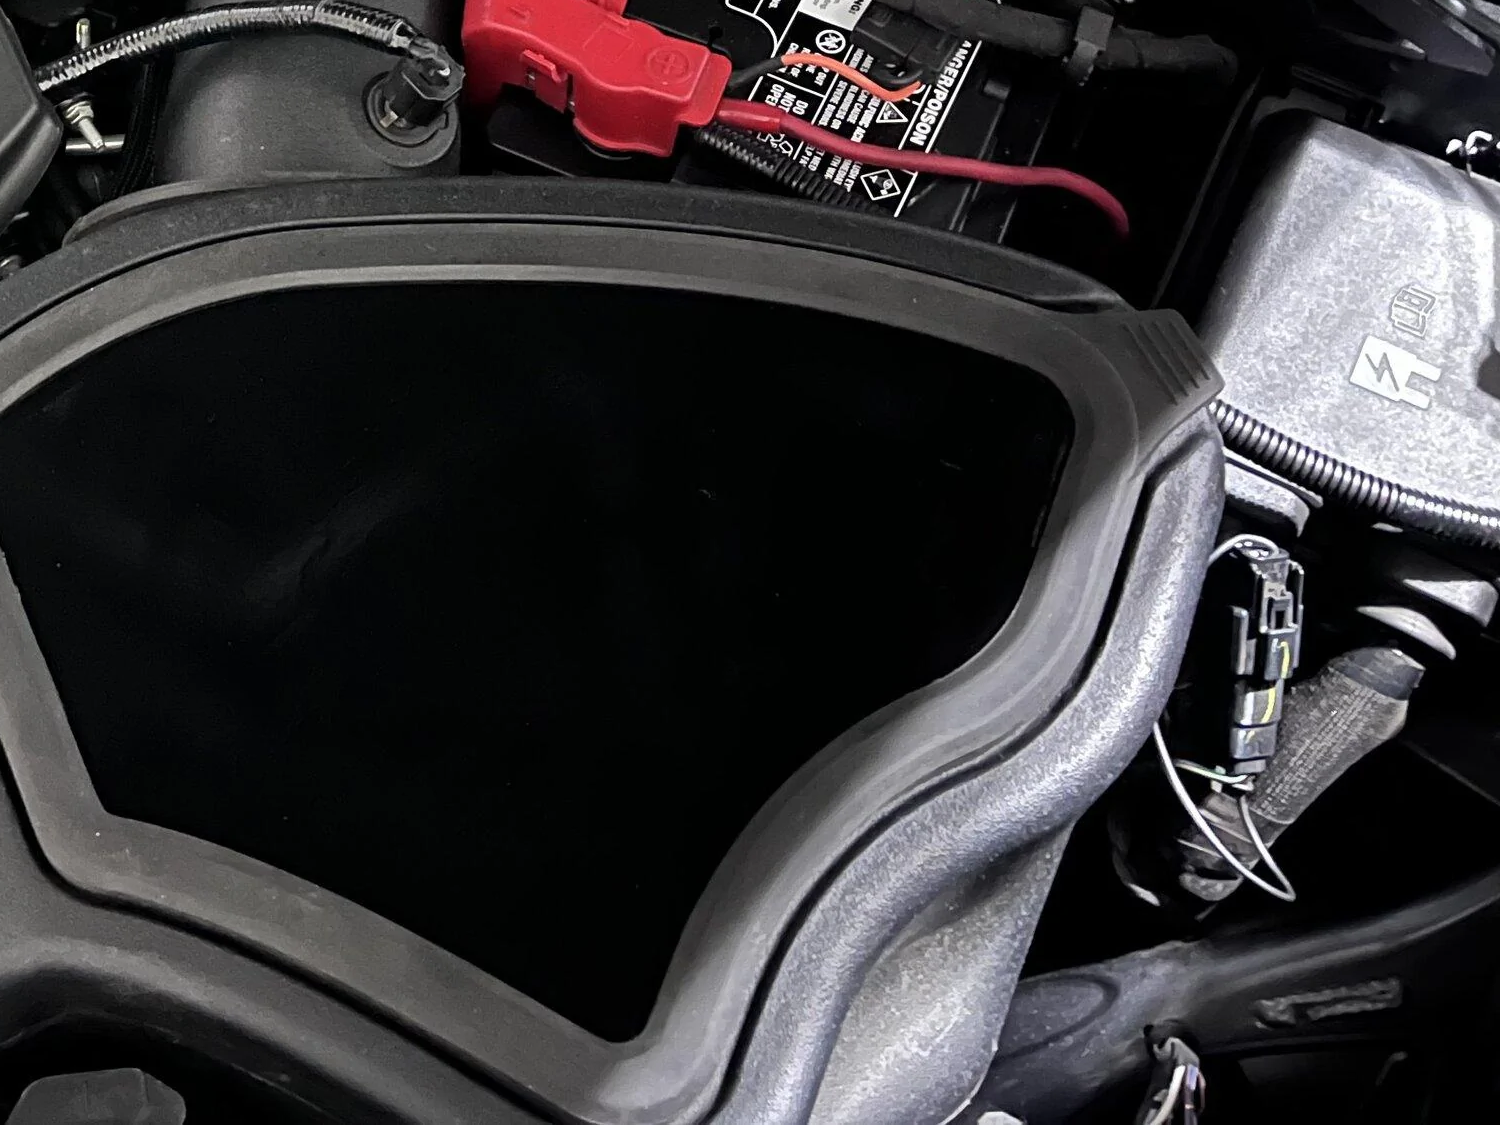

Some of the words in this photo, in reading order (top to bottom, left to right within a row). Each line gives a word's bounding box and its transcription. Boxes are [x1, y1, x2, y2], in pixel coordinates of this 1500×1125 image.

[860, 54, 874, 73] AMES
[765, 84, 784, 107] OPE
[778, 92, 796, 113] NOT
[910, 41, 971, 145] ANGER/POISON
[792, 100, 808, 115] DO
[808, 155, 821, 171] MED
